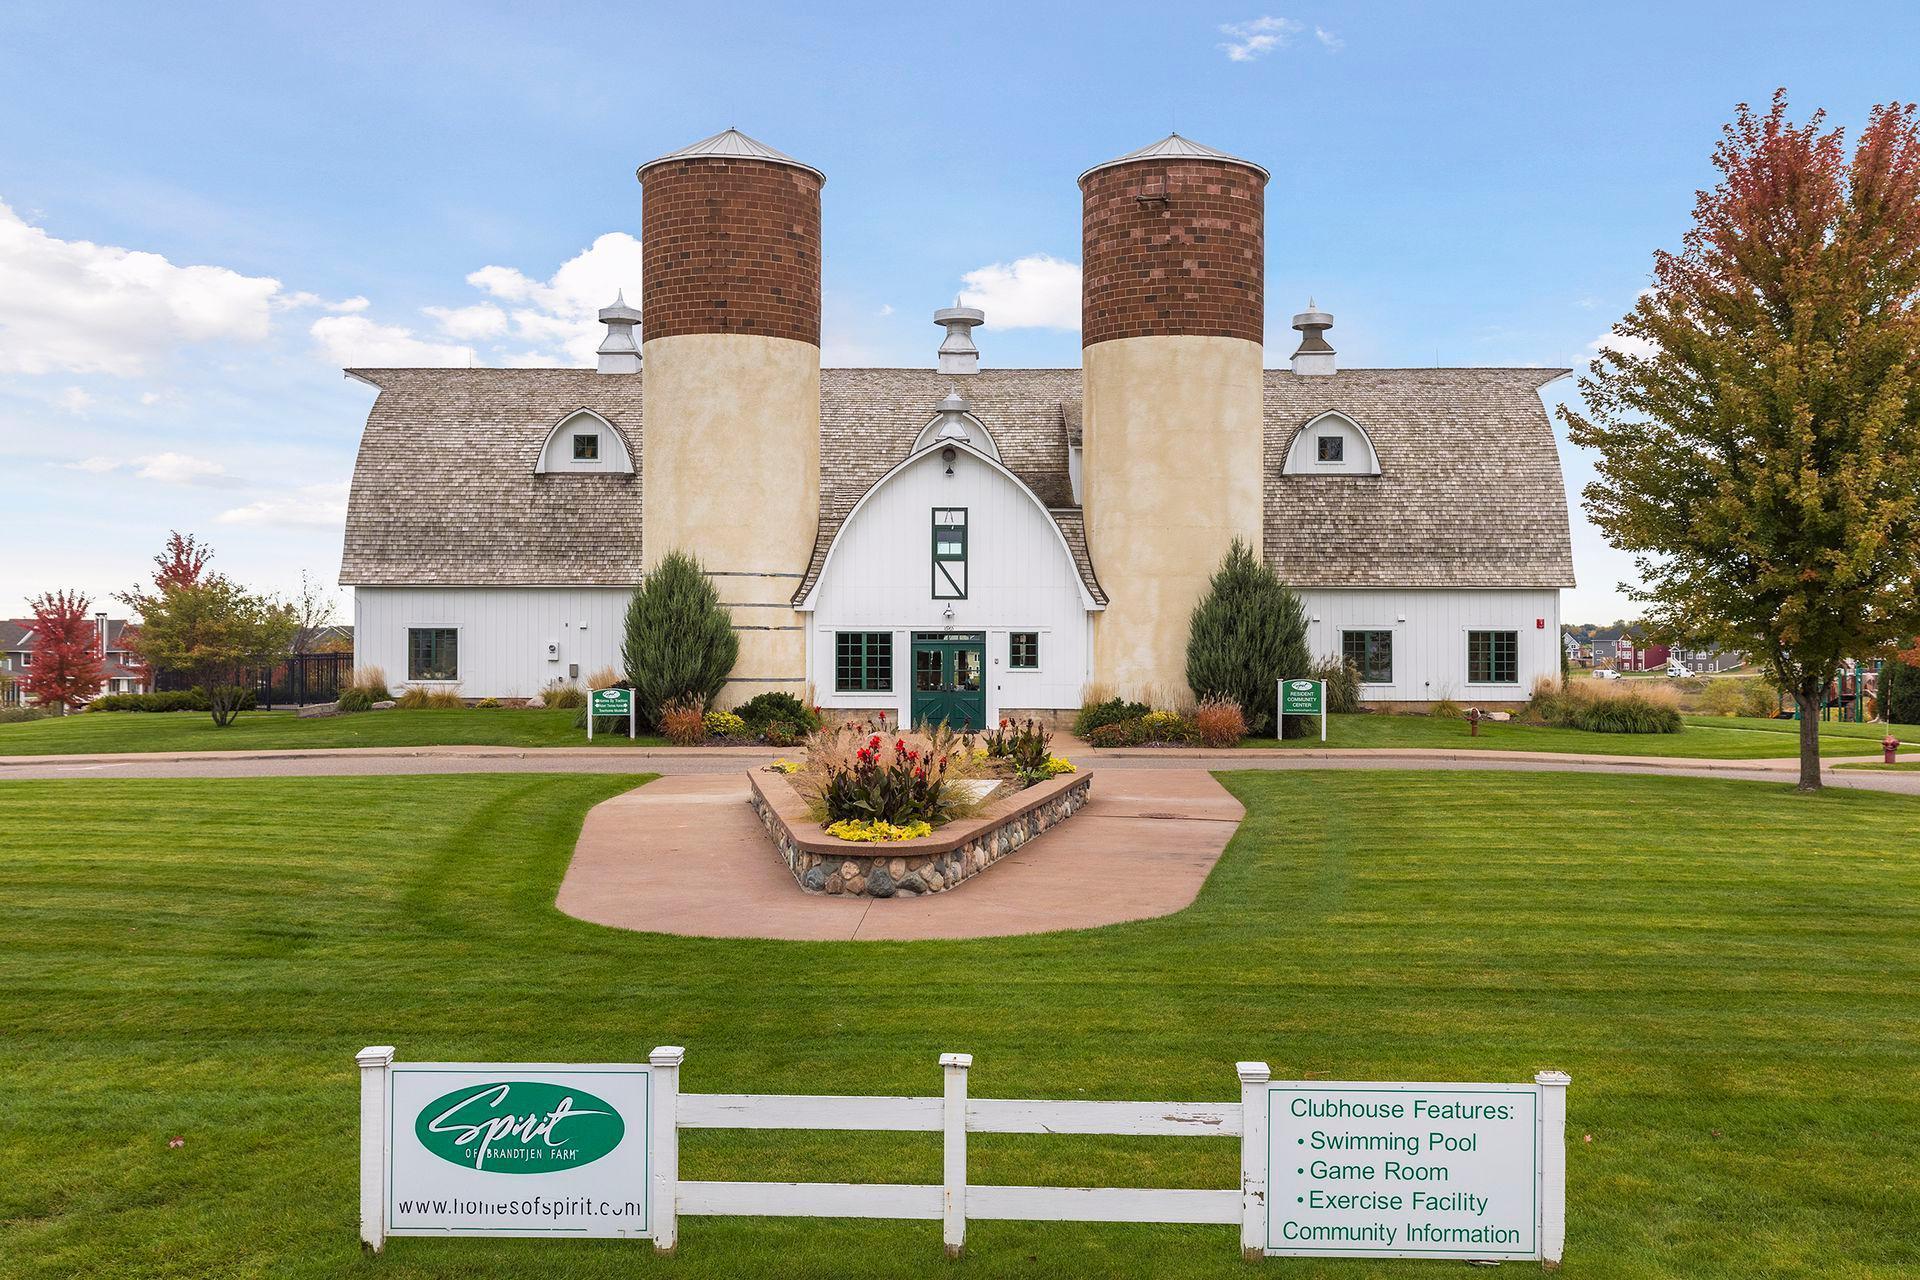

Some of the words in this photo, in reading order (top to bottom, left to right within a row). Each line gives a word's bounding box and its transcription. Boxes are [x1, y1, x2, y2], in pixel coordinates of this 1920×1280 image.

[1291, 1098, 1404, 1118] Clubhouse
[1415, 1100, 1514, 1119] Features:
[429, 1084, 612, 1169] Spirit
[466, 1149, 477, 1158] OF
[487, 1148, 542, 1161] BRANDTJEN
[1311, 1131, 1419, 1155] Swimming
[1430, 1132, 1476, 1151] Pool
[1311, 1161, 1374, 1180] Game
[1385, 1162, 1448, 1181] Room
[1310, 1190, 1402, 1210] Exercise
[1412, 1192, 1488, 1216] Facility
[1283, 1221, 1397, 1246] Community
[1407, 1223, 1520, 1243] Information
